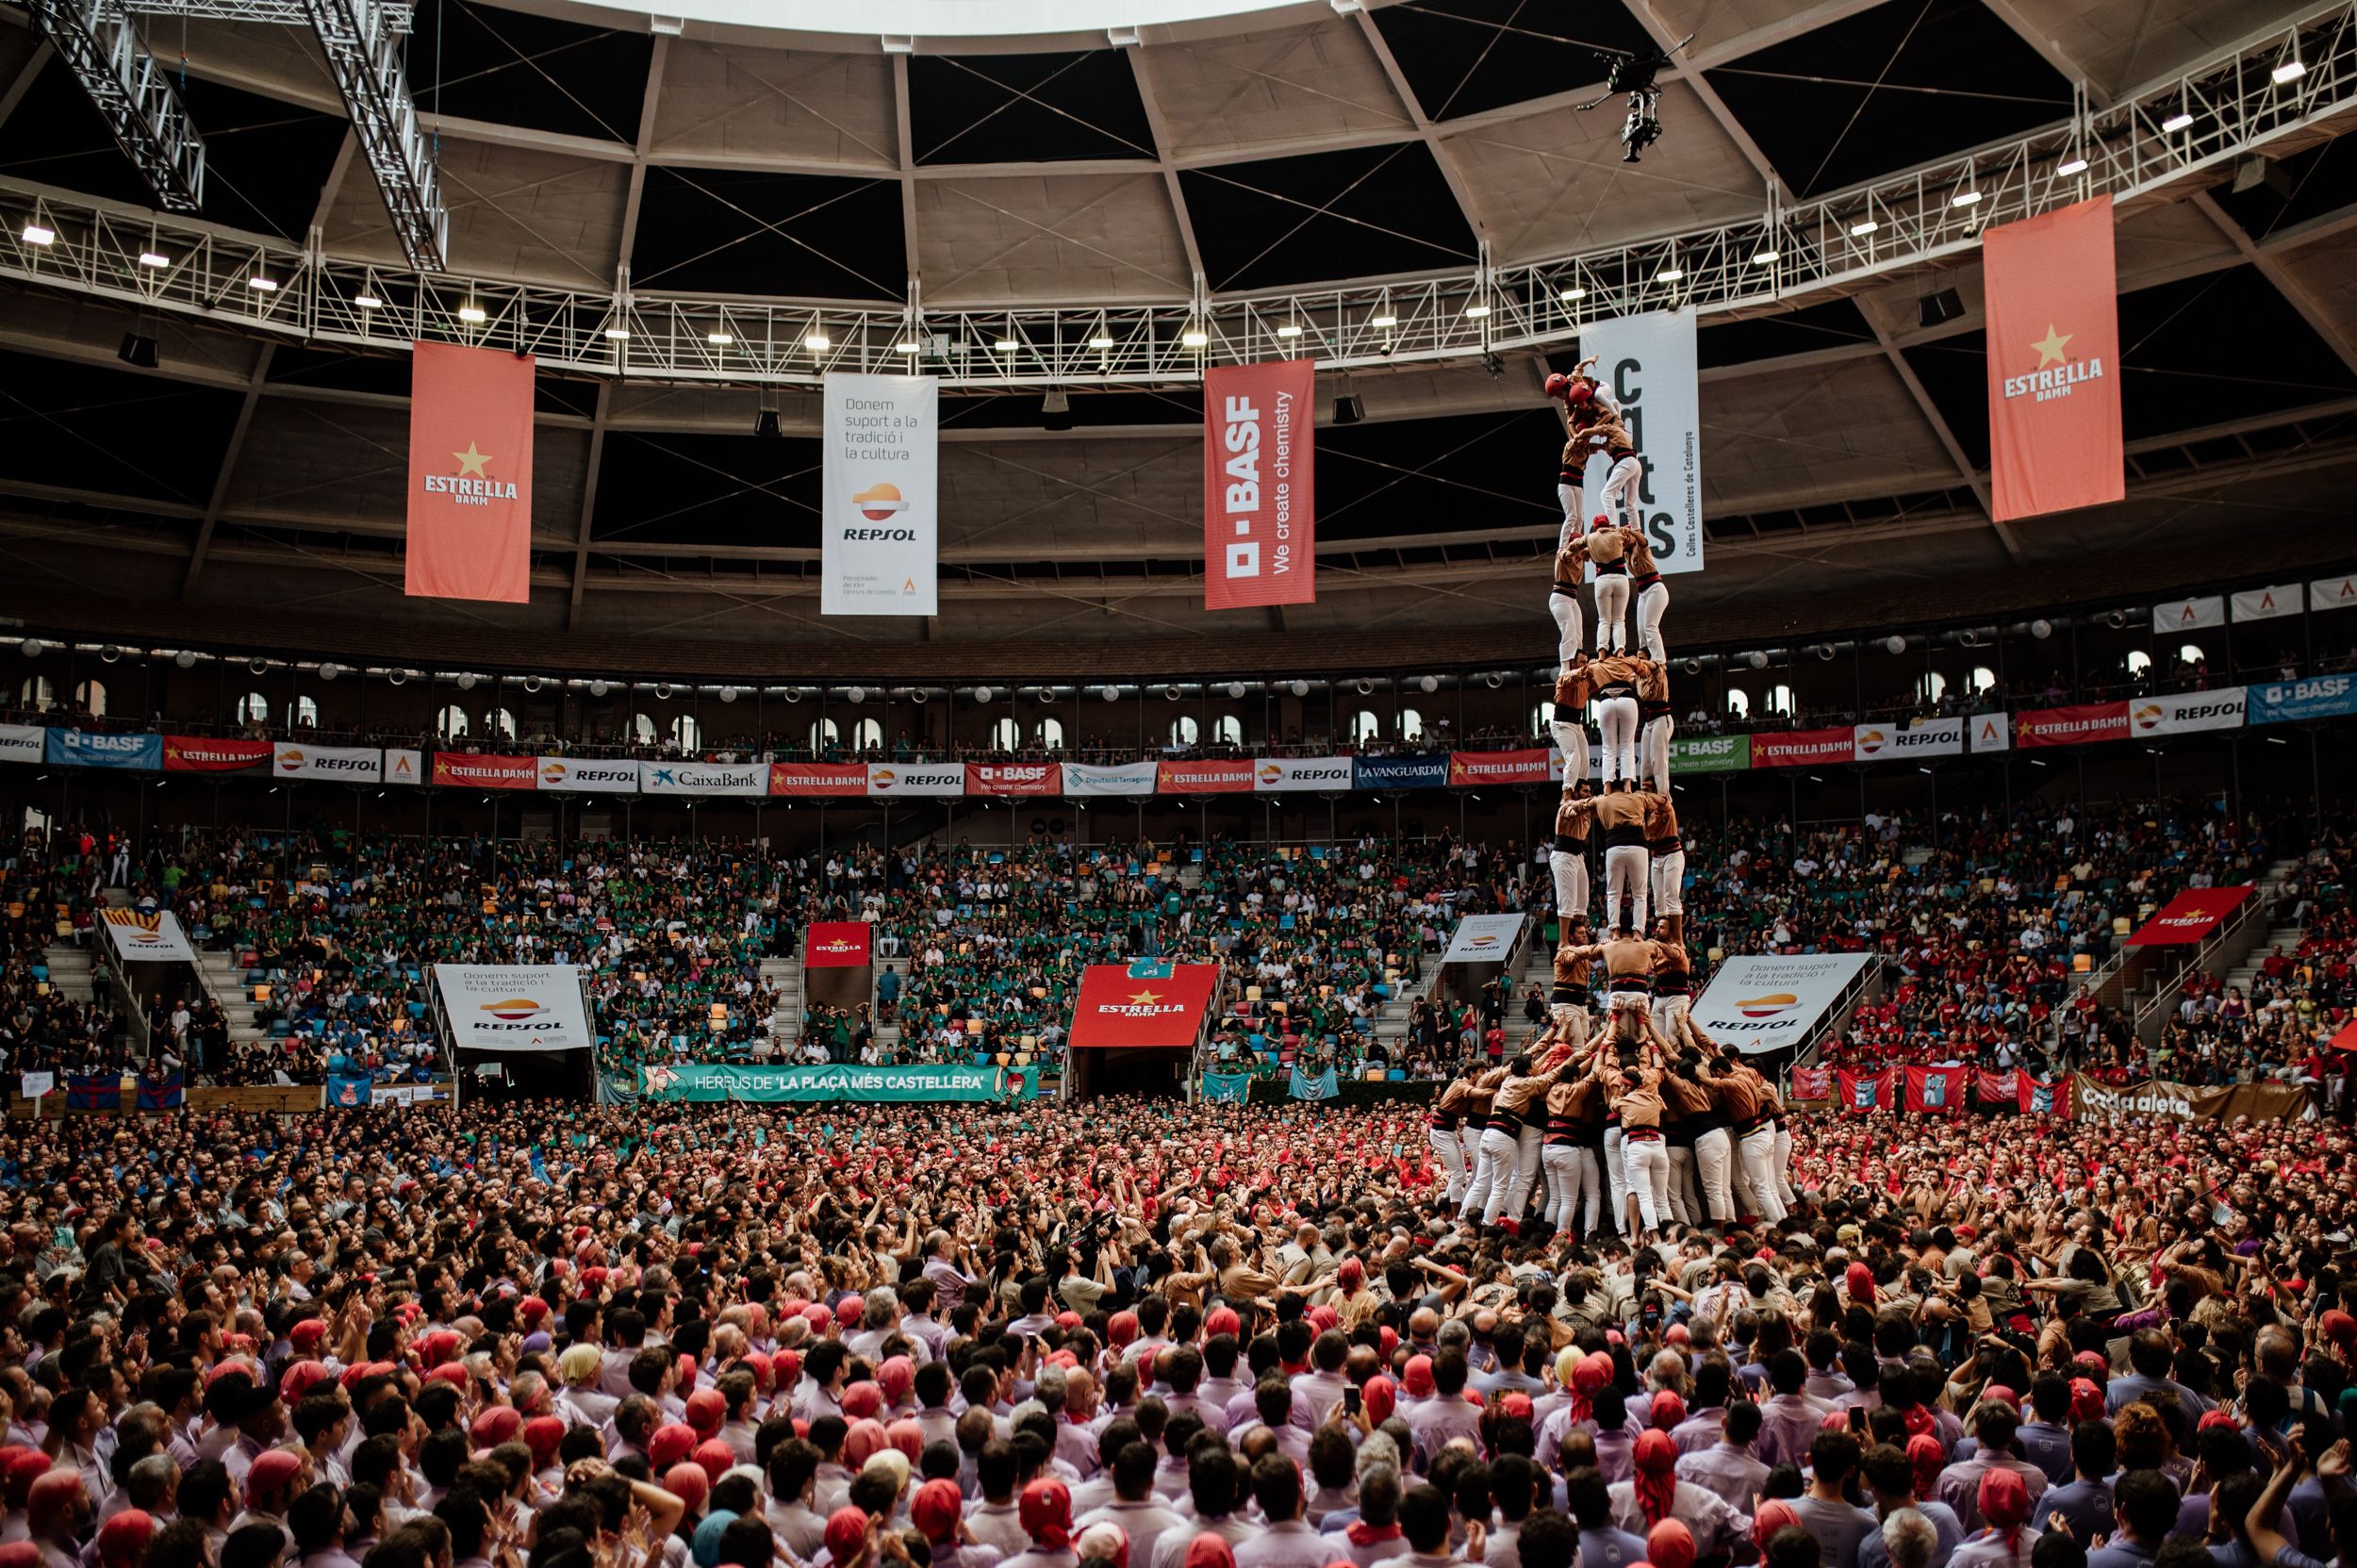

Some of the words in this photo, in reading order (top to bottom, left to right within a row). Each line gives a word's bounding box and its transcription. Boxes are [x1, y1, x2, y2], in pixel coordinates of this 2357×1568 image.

[2004, 357, 2103, 399] ESTRELLA
[2036, 385, 2071, 403] DAMM
[846, 398, 894, 410] Donem
[846, 416, 889, 429] suport
[894, 418, 901, 427] a
[906, 415, 917, 427] la
[846, 431, 896, 443] tradició
[899, 432, 903, 443] i
[1273, 390, 1293, 478] chemistry
[846, 447, 857, 459] la
[862, 448, 909, 460] cultura
[1225, 396, 1261, 513] BASF
[1683, 431, 1695, 471] Catalunya
[1684, 473, 1694, 483] de
[424, 475, 518, 499] ESTRELLA
[454, 494, 488, 505] DAMM
[1274, 485, 1290, 540] create
[1685, 486, 1695, 531] Castelleres
[843, 529, 916, 541] REPSOL
[1686, 533, 1696, 557] Colles
[1273, 544, 1290, 575] We
[2295, 678, 2350, 701] BASF
[2175, 701, 2245, 720] REPSOL
[2035, 719, 2089, 735] ESTRELLA
[2091, 716, 2128, 729] DAMM
[92, 735, 144, 751] BASF
[1895, 731, 1960, 747] REPSOL
[1689, 739, 1734, 755] BASF
[1767, 745, 1818, 756] ESTRELLA
[1820, 741, 1853, 753] DAMM
[183, 751, 236, 762] ESTRELLA
[315, 758, 378, 771] REPSOL
[1467, 764, 1514, 775] ESTRELLA
[1515, 762, 1547, 773] DAMM
[451, 767, 501, 778] ESTRELLA
[502, 768, 535, 779] DAMM
[576, 770, 636, 782] REPSOL
[1003, 767, 1046, 780] BASF
[1174, 773, 1221, 784] ESTRELLA
[1222, 772, 1253, 782] DAMM
[1292, 769, 1349, 780] REPSOL
[1359, 767, 1372, 778] LA
[1371, 765, 1445, 777] VANGUARDIA
[679, 771, 758, 787] CaixaBank
[786, 776, 833, 785] ESTRELLA
[834, 776, 865, 785] DAMM
[905, 775, 962, 785] REPSOL
[1085, 775, 1118, 785] Diputació
[1119, 776, 1152, 785] Tarragona
[2158, 916, 2215, 925] ESTRELLA
[1797, 962, 1838, 971] suport
[511, 972, 551, 981] suport
[1771, 970, 1819, 979] tradició
[1754, 979, 1800, 987] cultura
[1097, 1004, 1184, 1013] ESTRELLA
[473, 1022, 564, 1031] REPSOL
[1706, 1018, 1799, 1031] REPSOL
[695, 1076, 751, 1090] HEREUS
[754, 1077, 772, 1090] DE
[801, 1076, 849, 1092] PLAÇA
[851, 1073, 884, 1089] MÉS
[885, 1076, 984, 1089] CASTELLERA’
[2082, 1088, 2134, 1111] Cada
[2136, 1094, 2196, 1120] aleta,
